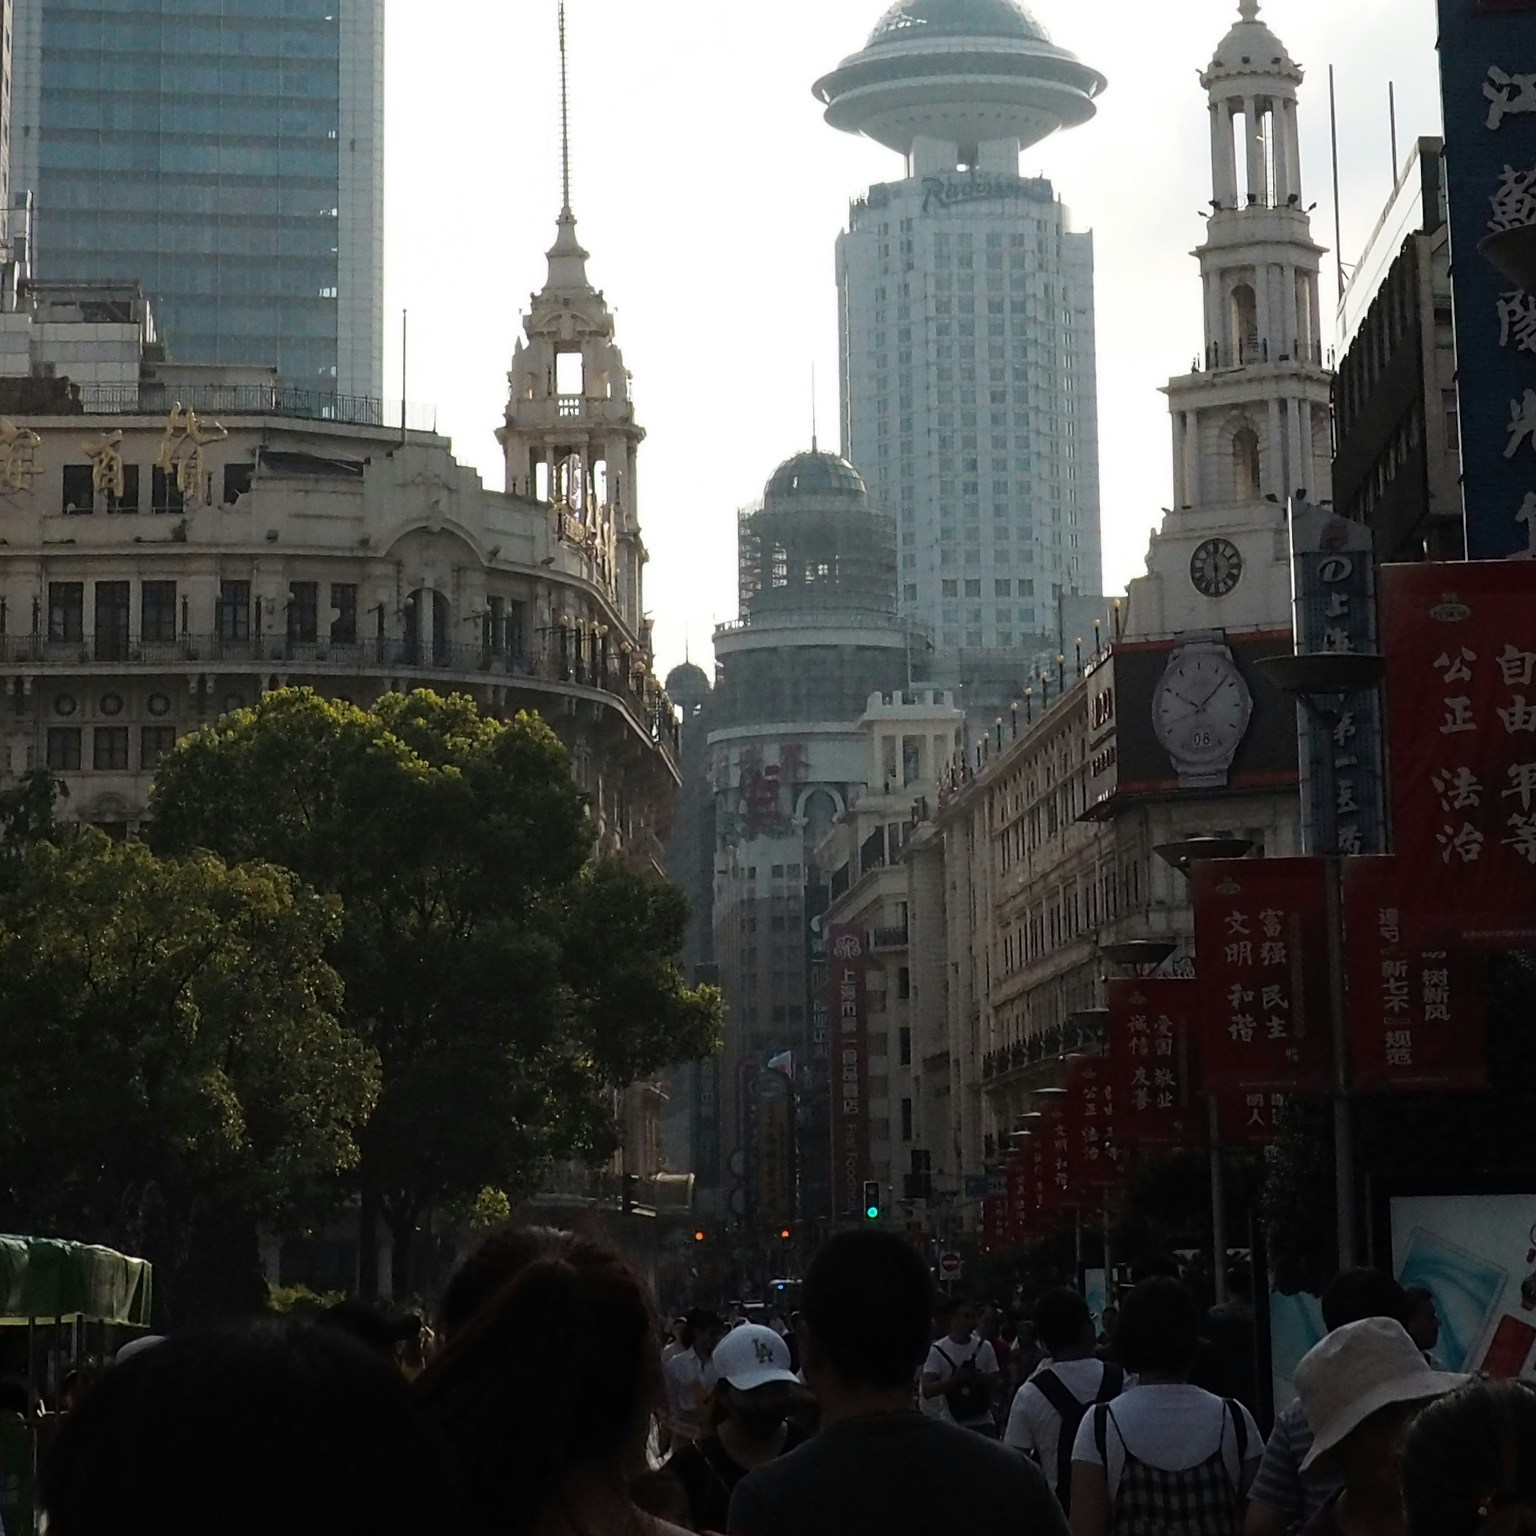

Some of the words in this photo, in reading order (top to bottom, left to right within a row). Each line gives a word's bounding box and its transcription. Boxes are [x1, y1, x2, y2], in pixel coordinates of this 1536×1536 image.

[1431, 645, 1480, 735] 公正
[1430, 766, 1486, 865] 法治
[1223, 909, 1253, 967] 文明
